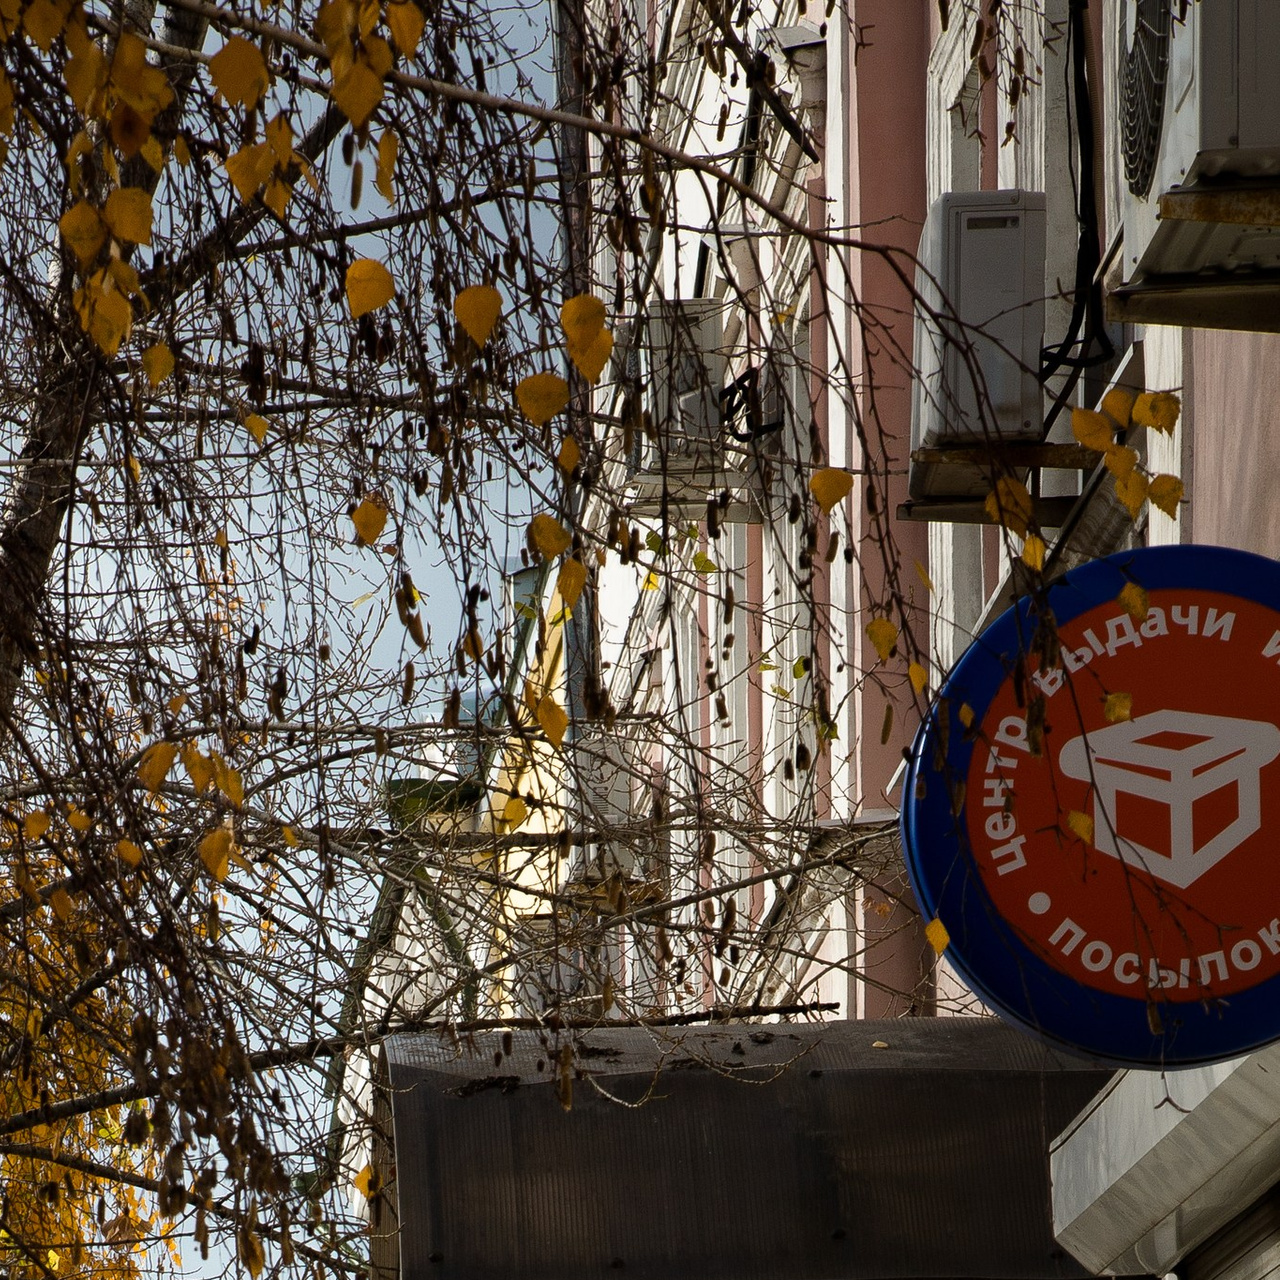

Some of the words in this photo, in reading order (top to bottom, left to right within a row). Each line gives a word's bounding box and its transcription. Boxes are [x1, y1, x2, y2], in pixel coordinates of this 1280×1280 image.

[983, 715, 1031, 876] центр
[1032, 605, 1237, 698] выдачи
[1048, 917, 1280, 989] посылок
